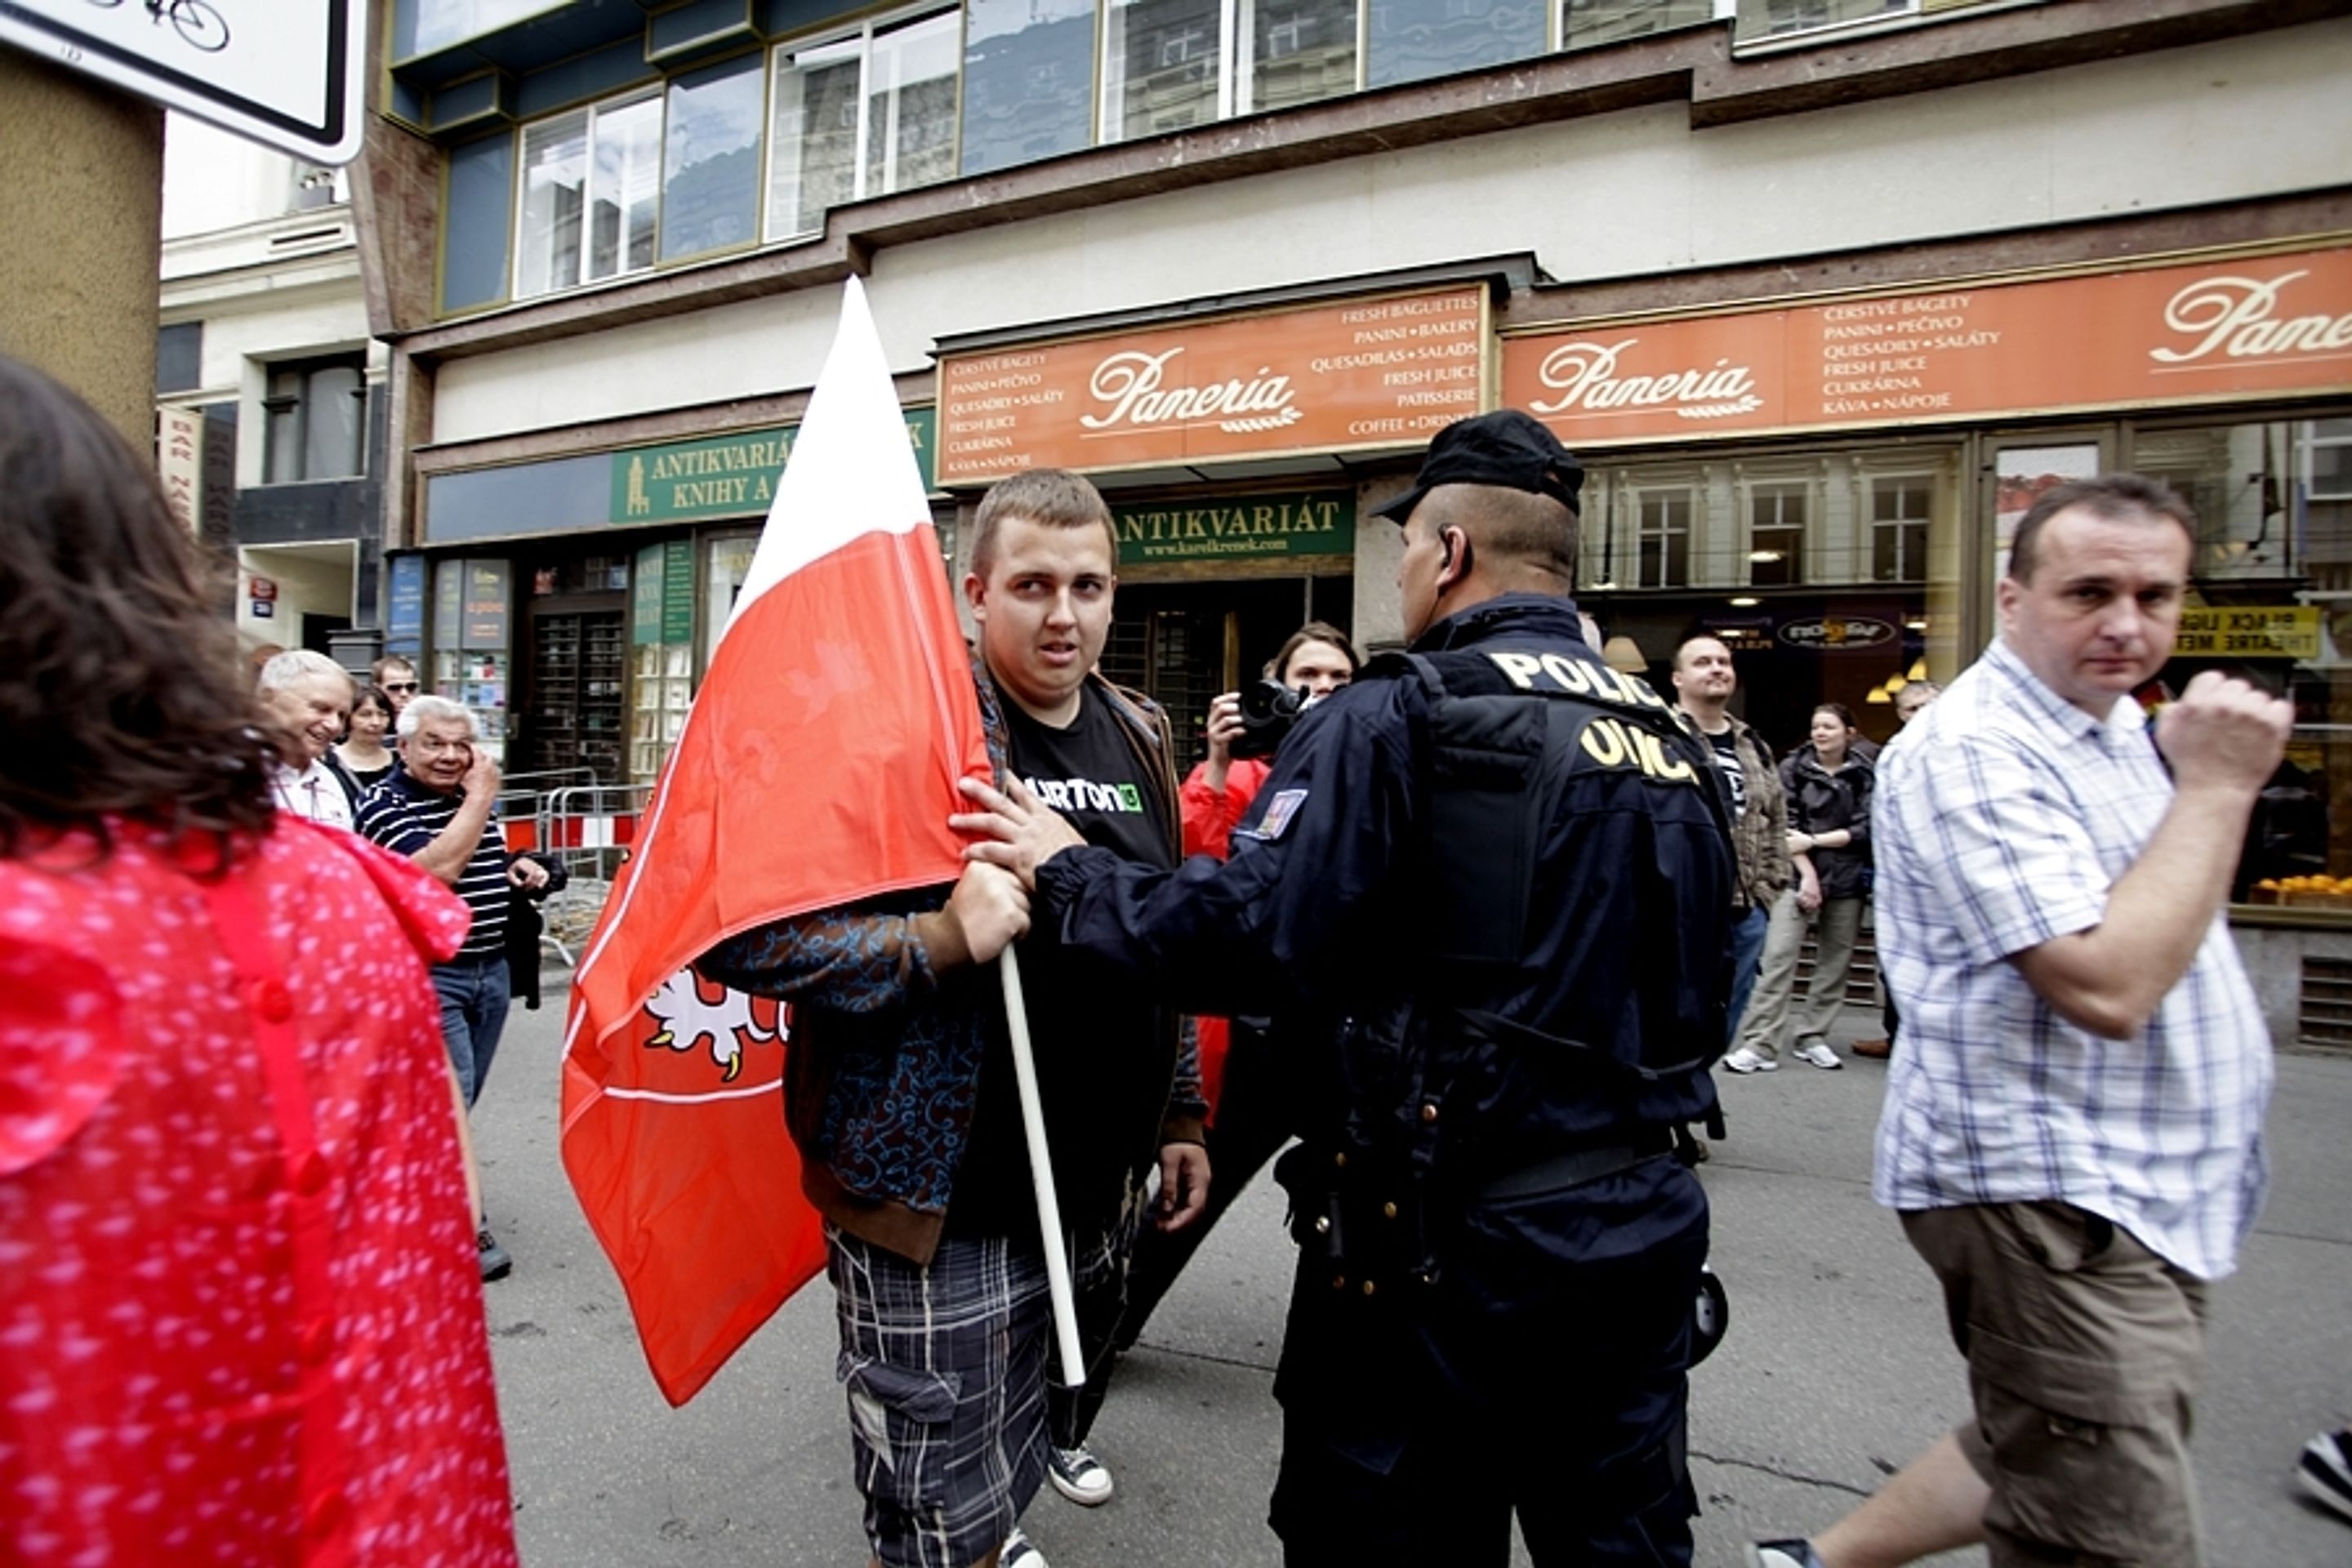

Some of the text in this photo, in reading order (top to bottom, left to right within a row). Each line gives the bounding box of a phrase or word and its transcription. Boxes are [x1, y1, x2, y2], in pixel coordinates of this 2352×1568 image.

[1342, 296, 1478, 323] FRESH BAGUETTES
[1901, 294, 1971, 314] BAGETY
[1353, 318, 1478, 345] PANINI BAKERY
[1824, 315, 1964, 340] PANINI PEČIVO
[1417, 342, 1479, 359] SALADS
[1823, 331, 2001, 360] QUESADILY SALÁTY
[1384, 365, 1479, 386] FRESH JUICE
[1528, 338, 1754, 414] Panería
[1824, 355, 1927, 377] FRESH JUICE
[951, 379, 989, 395] PANINI
[1079, 346, 1295, 428] Panería
[1397, 389, 1477, 408] PATISSERIE
[1823, 376, 1922, 396] CUKRÁRNA
[1823, 391, 1952, 415] KÁVA NÁPOJE
[1349, 417, 1405, 435] COFFEE
[652, 432, 792, 479] ANTIKVARIÁ
[673, 475, 770, 508] KNIHY A
[1116, 495, 1340, 542] NTIKVARIÁT
[1489, 653, 1671, 709] POLIC
